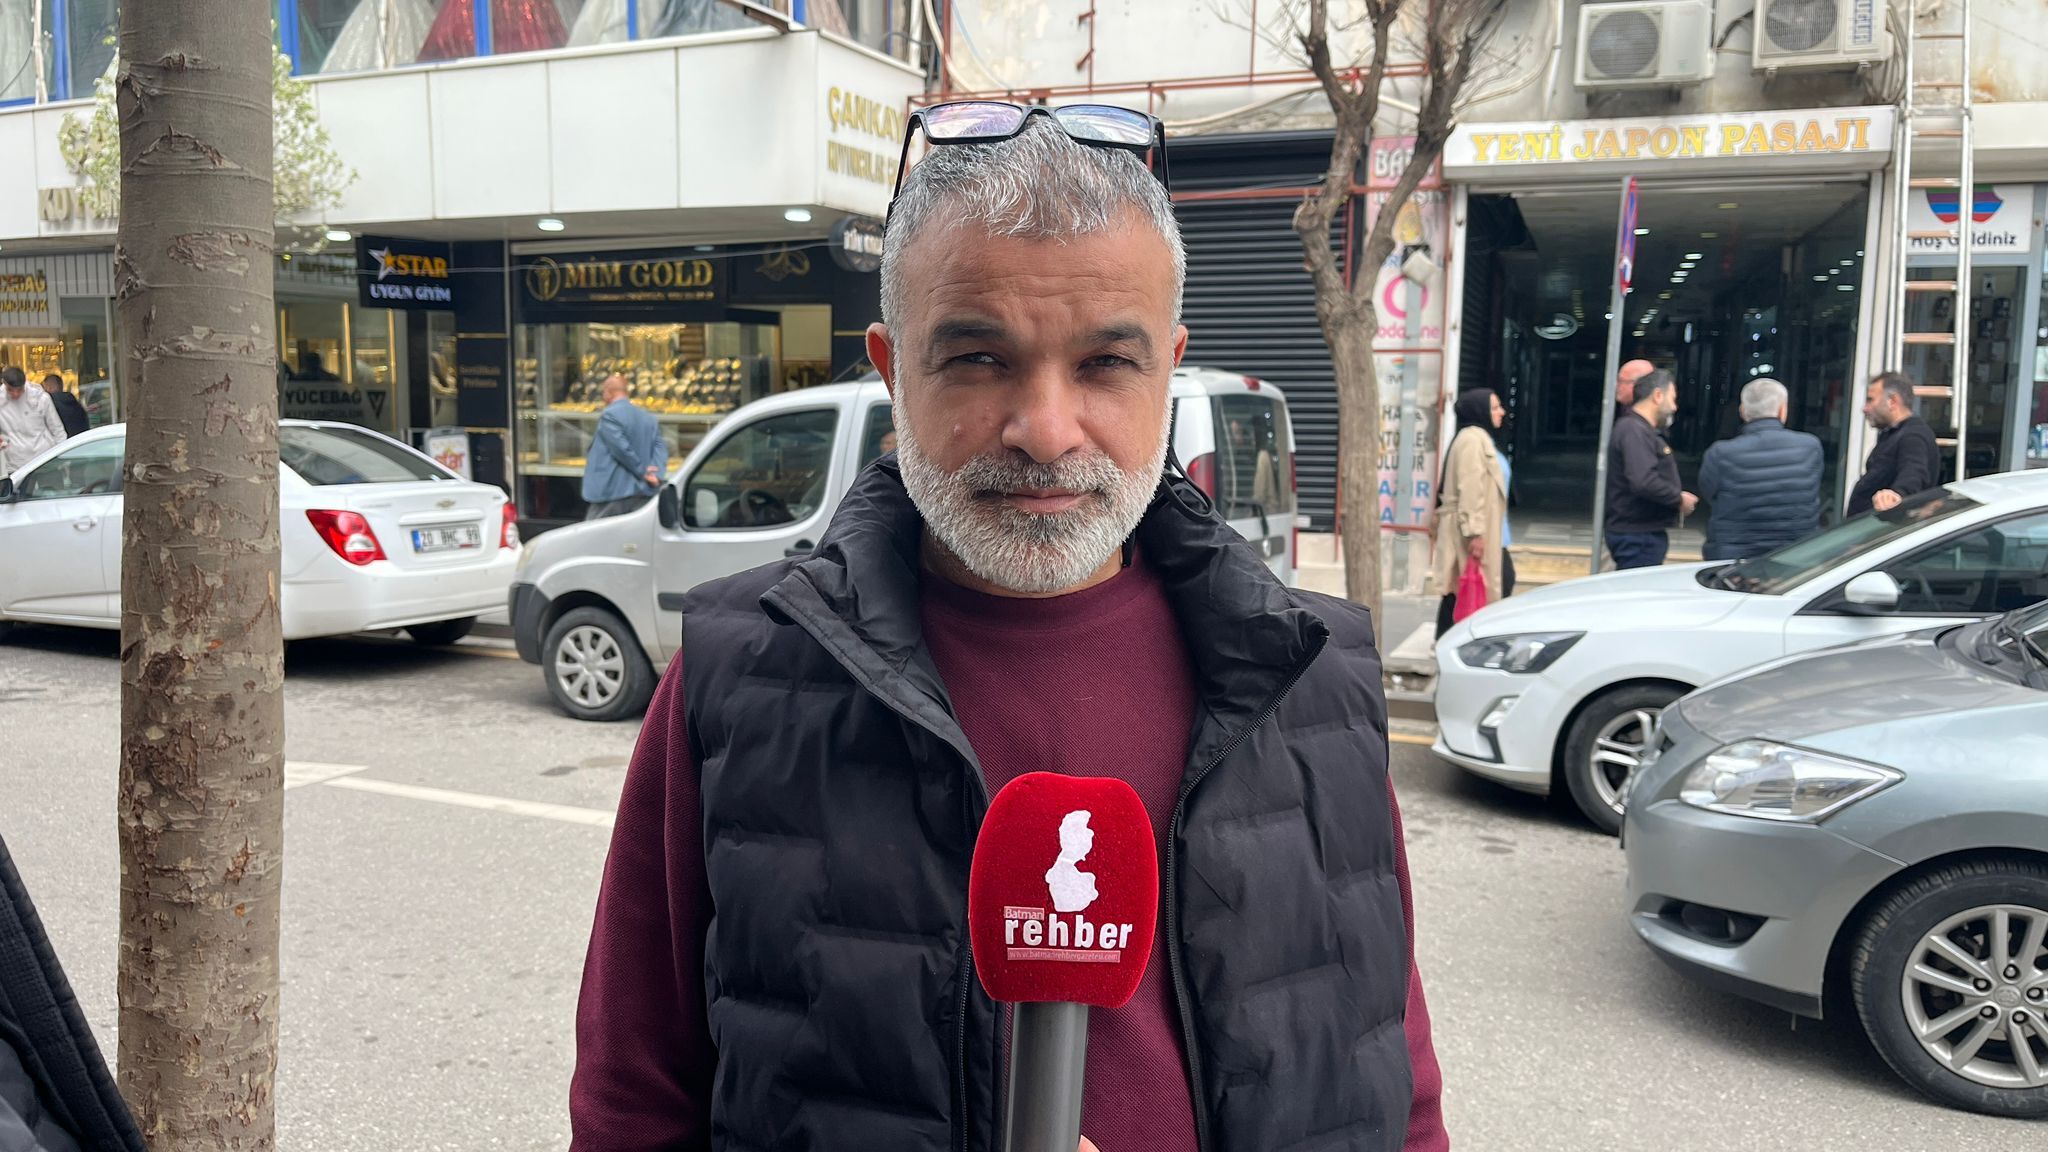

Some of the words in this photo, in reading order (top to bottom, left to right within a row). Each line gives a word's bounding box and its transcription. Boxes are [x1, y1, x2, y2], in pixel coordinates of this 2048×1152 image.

[828, 86, 905, 145] ÇANKAY
[1472, 125, 1560, 163] YENİ
[1573, 125, 1707, 160] JAPON
[1719, 118, 1872, 154] PASAJI
[1949, 231, 2016, 247] Gldiniz
[395, 254, 448, 279] STAR
[564, 256, 622, 289] MİM
[629, 259, 713, 288] GOLD
[370, 283, 413, 301] UYGUN
[415, 283, 451, 302] GİYİM
[285, 386, 362, 405] YÜCEBAĞ
[422, 532, 433, 546] 20
[1004, 908, 1043, 920] Batman
[1005, 913, 1133, 949] rehber
